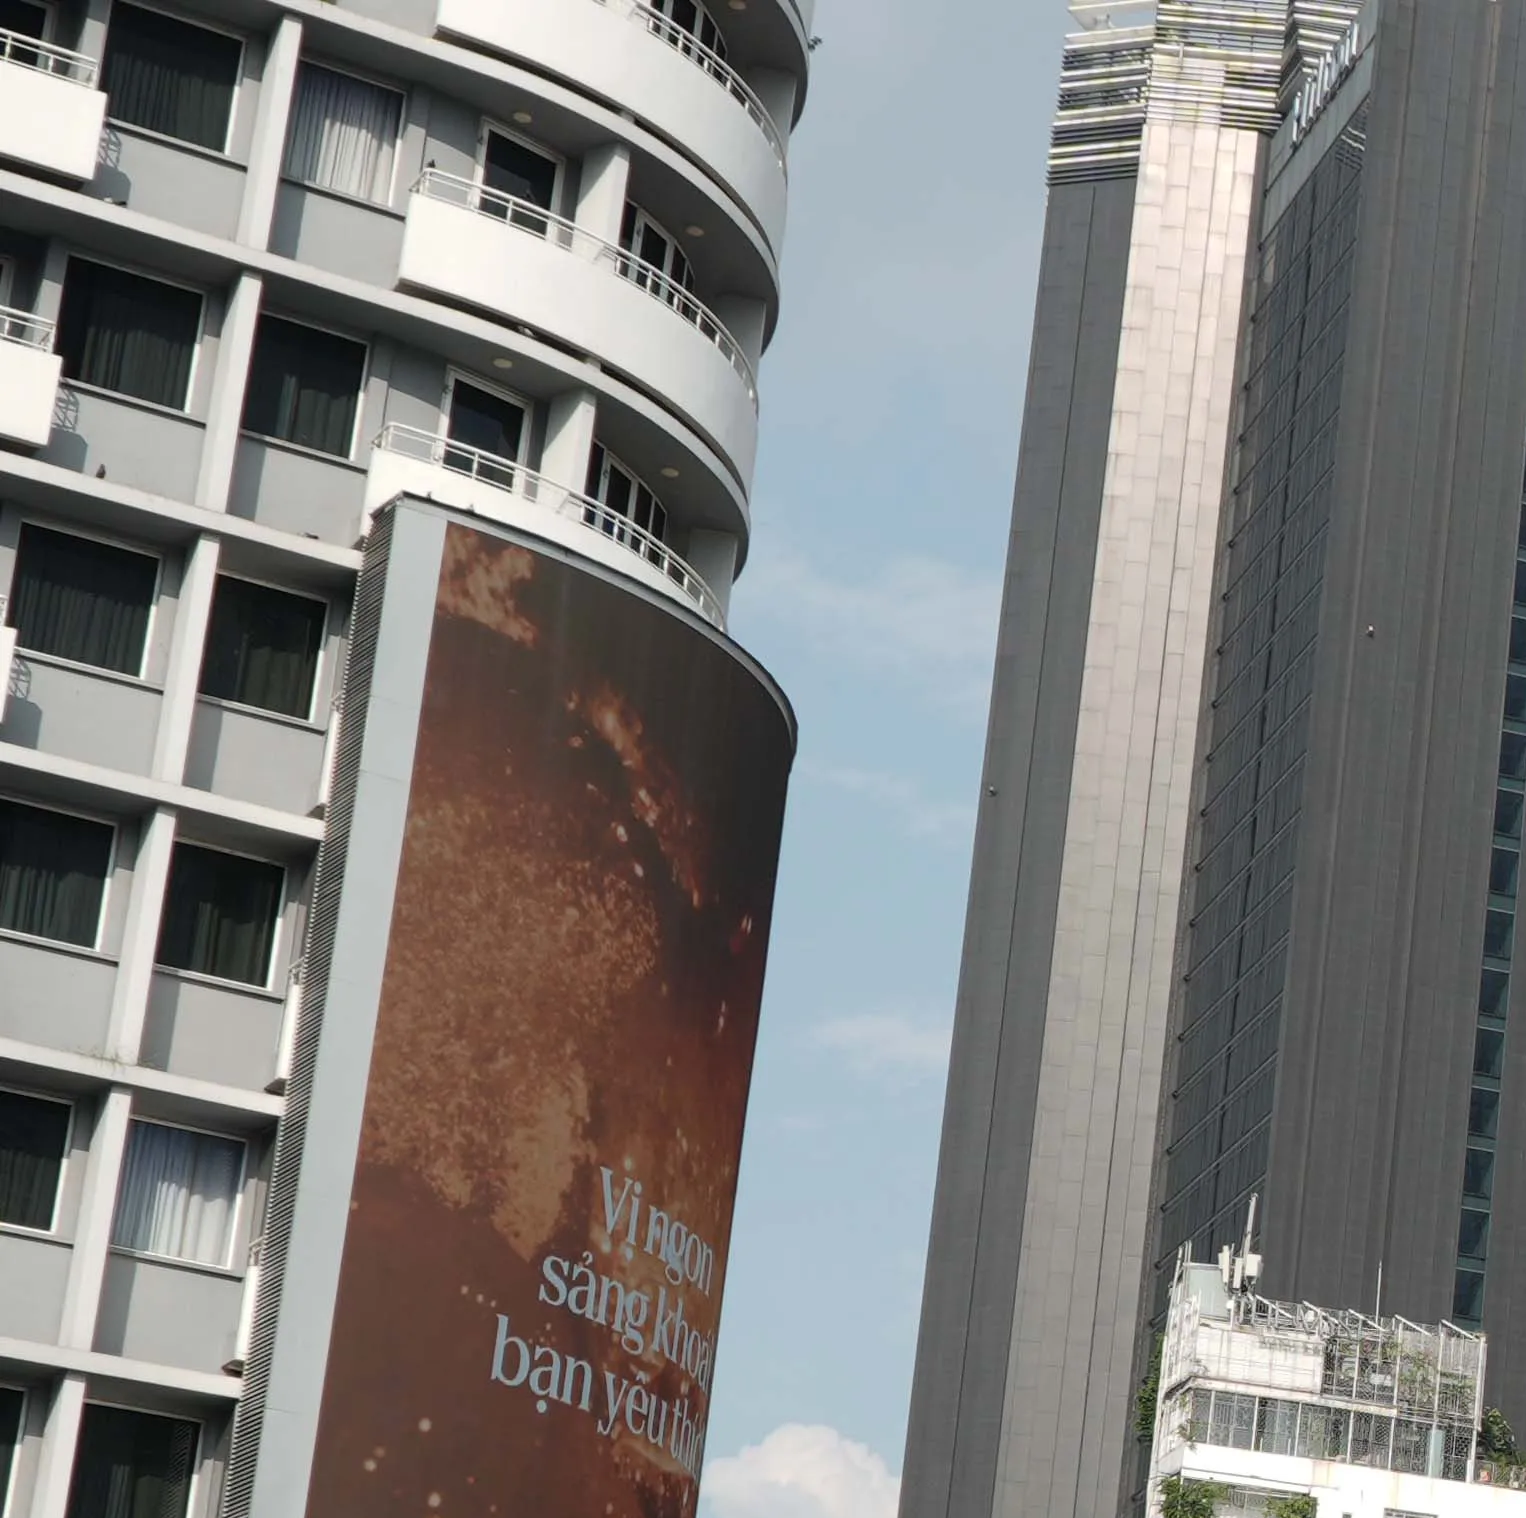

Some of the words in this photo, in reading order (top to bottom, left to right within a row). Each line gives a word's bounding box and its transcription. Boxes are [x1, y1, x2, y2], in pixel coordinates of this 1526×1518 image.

[600, 1166, 642, 1261] Vị
[645, 1204, 714, 1297] ngon
[539, 1251, 649, 1355] sảng
[491, 1313, 593, 1414] bạn
[597, 1371, 668, 1448] yêu
